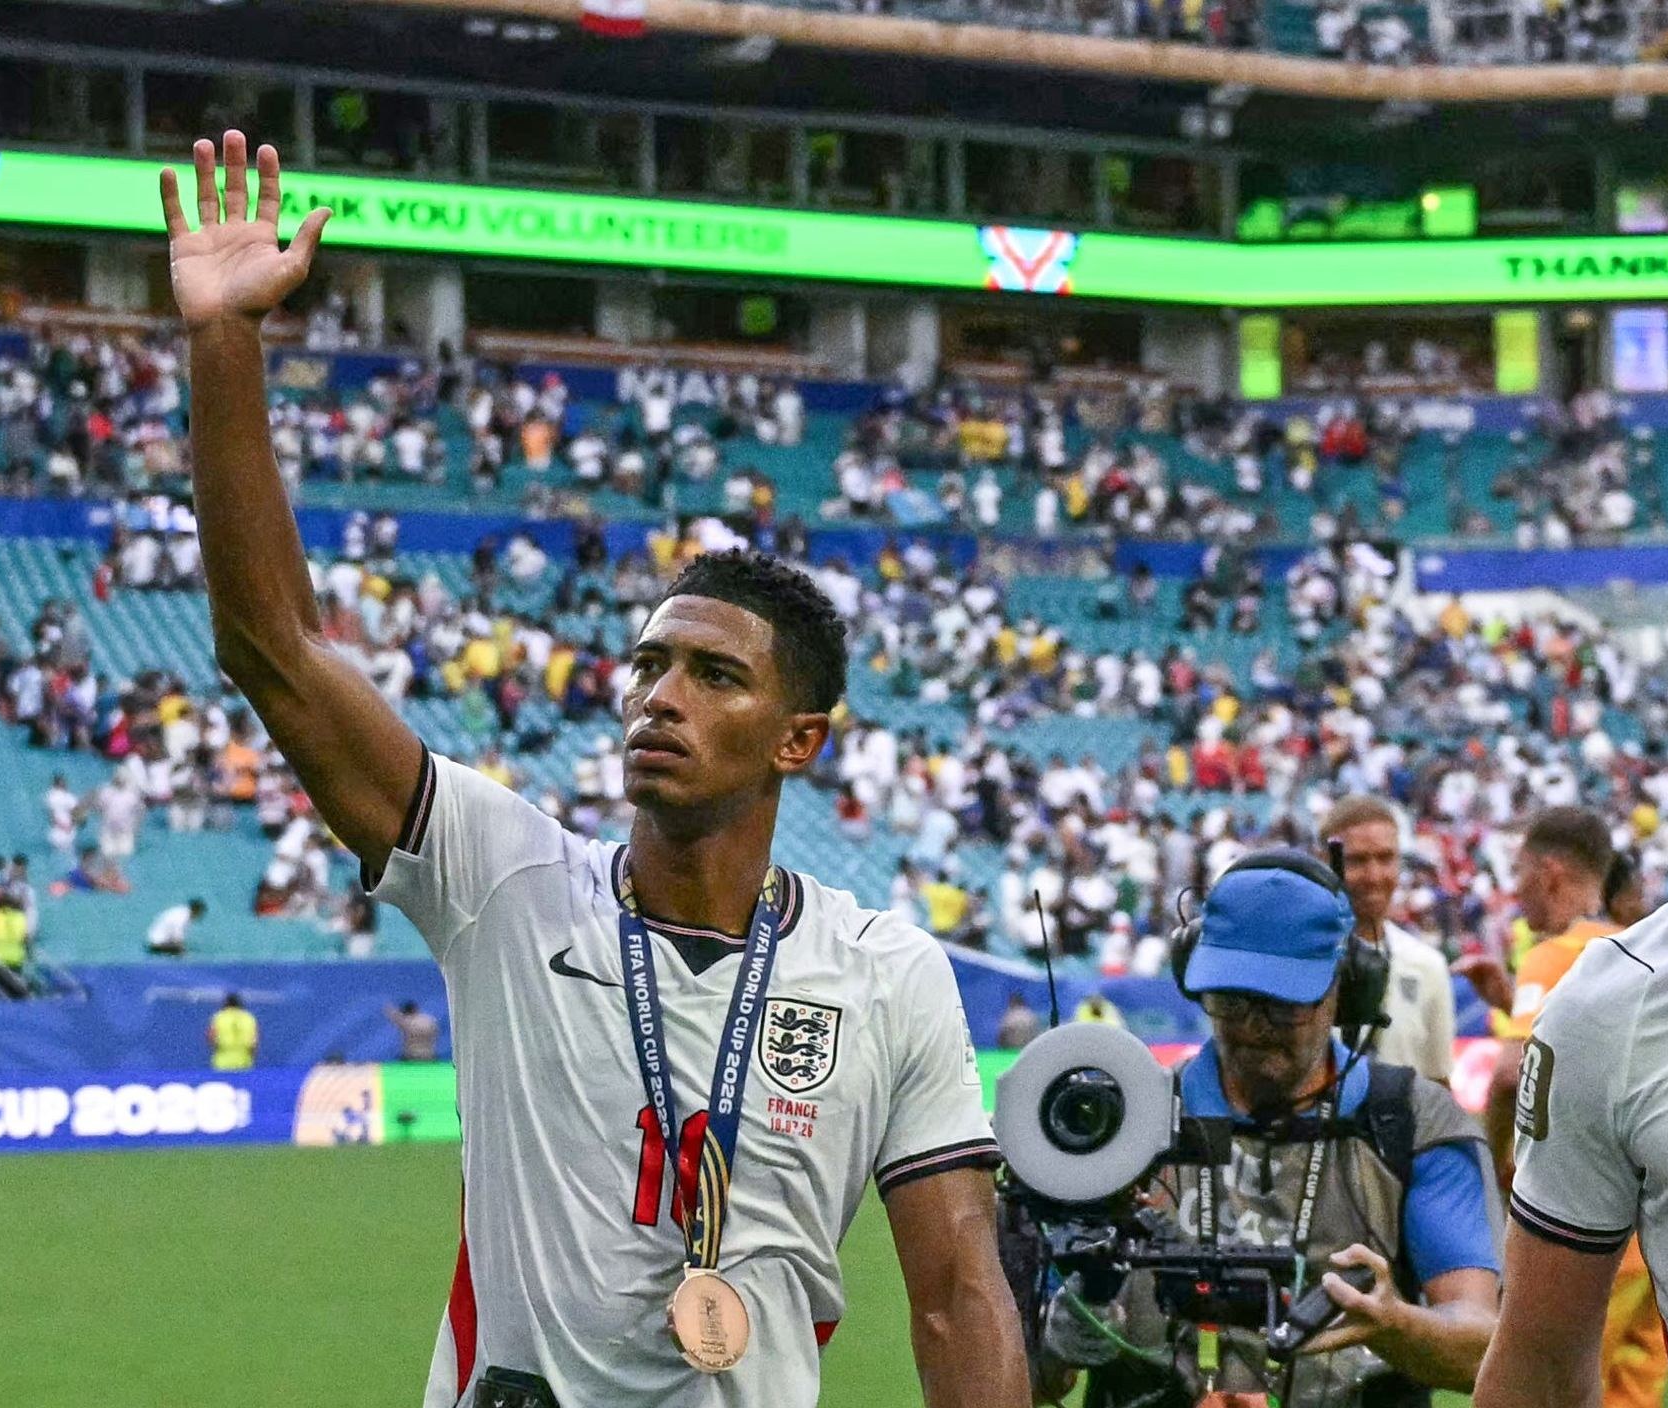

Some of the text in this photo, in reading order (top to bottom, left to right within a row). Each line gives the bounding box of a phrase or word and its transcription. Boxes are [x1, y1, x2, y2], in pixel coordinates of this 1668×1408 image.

[627, 934, 670, 1140] FIFA WORLD CUP 2026
[718, 921, 772, 1115] FIFA WORLD CUP 2026
[71, 1082, 237, 1137] 2026
[768, 1097, 819, 1119] FRANCE
[1305, 1173, 1319, 1197] CUP
